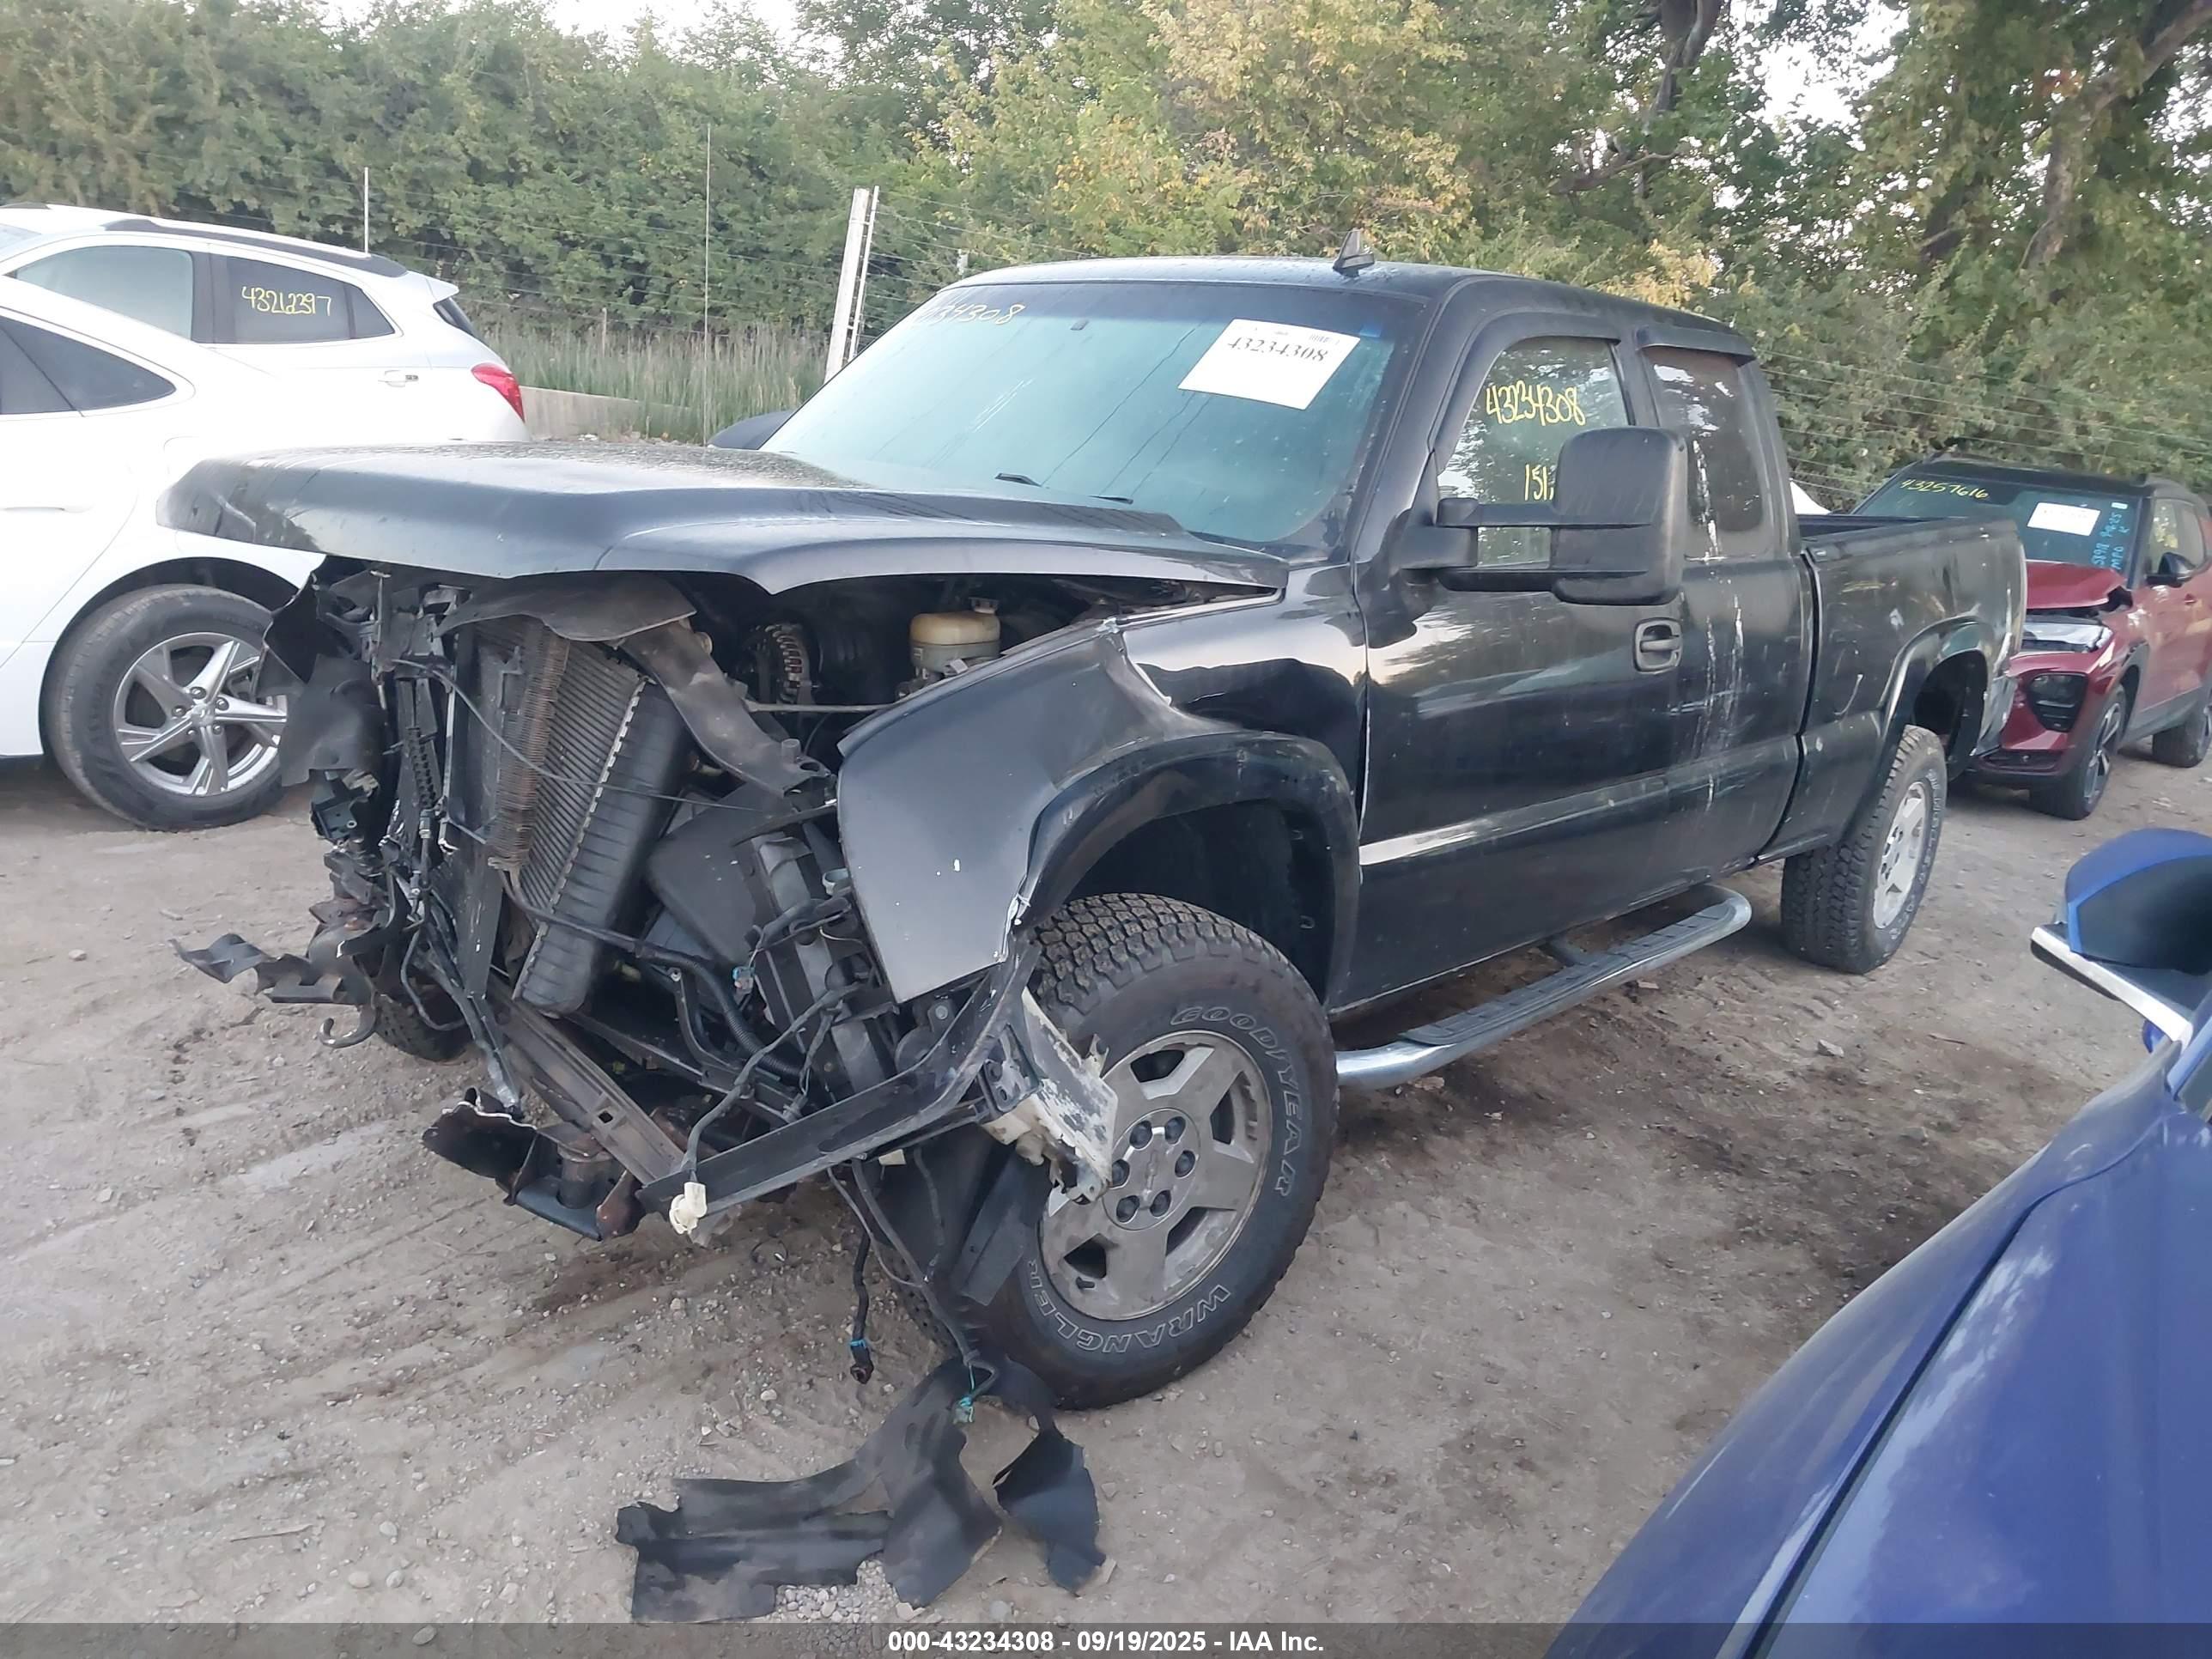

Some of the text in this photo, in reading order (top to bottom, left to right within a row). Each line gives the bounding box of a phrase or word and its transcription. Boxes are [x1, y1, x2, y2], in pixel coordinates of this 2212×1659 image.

[1227, 337, 1328, 362] 43234308
[1486, 380, 1586, 426] 43234308
[1170, 1006, 1303, 1197] GOODYEAR
[1028, 1259, 1231, 1352] WRANGLER
